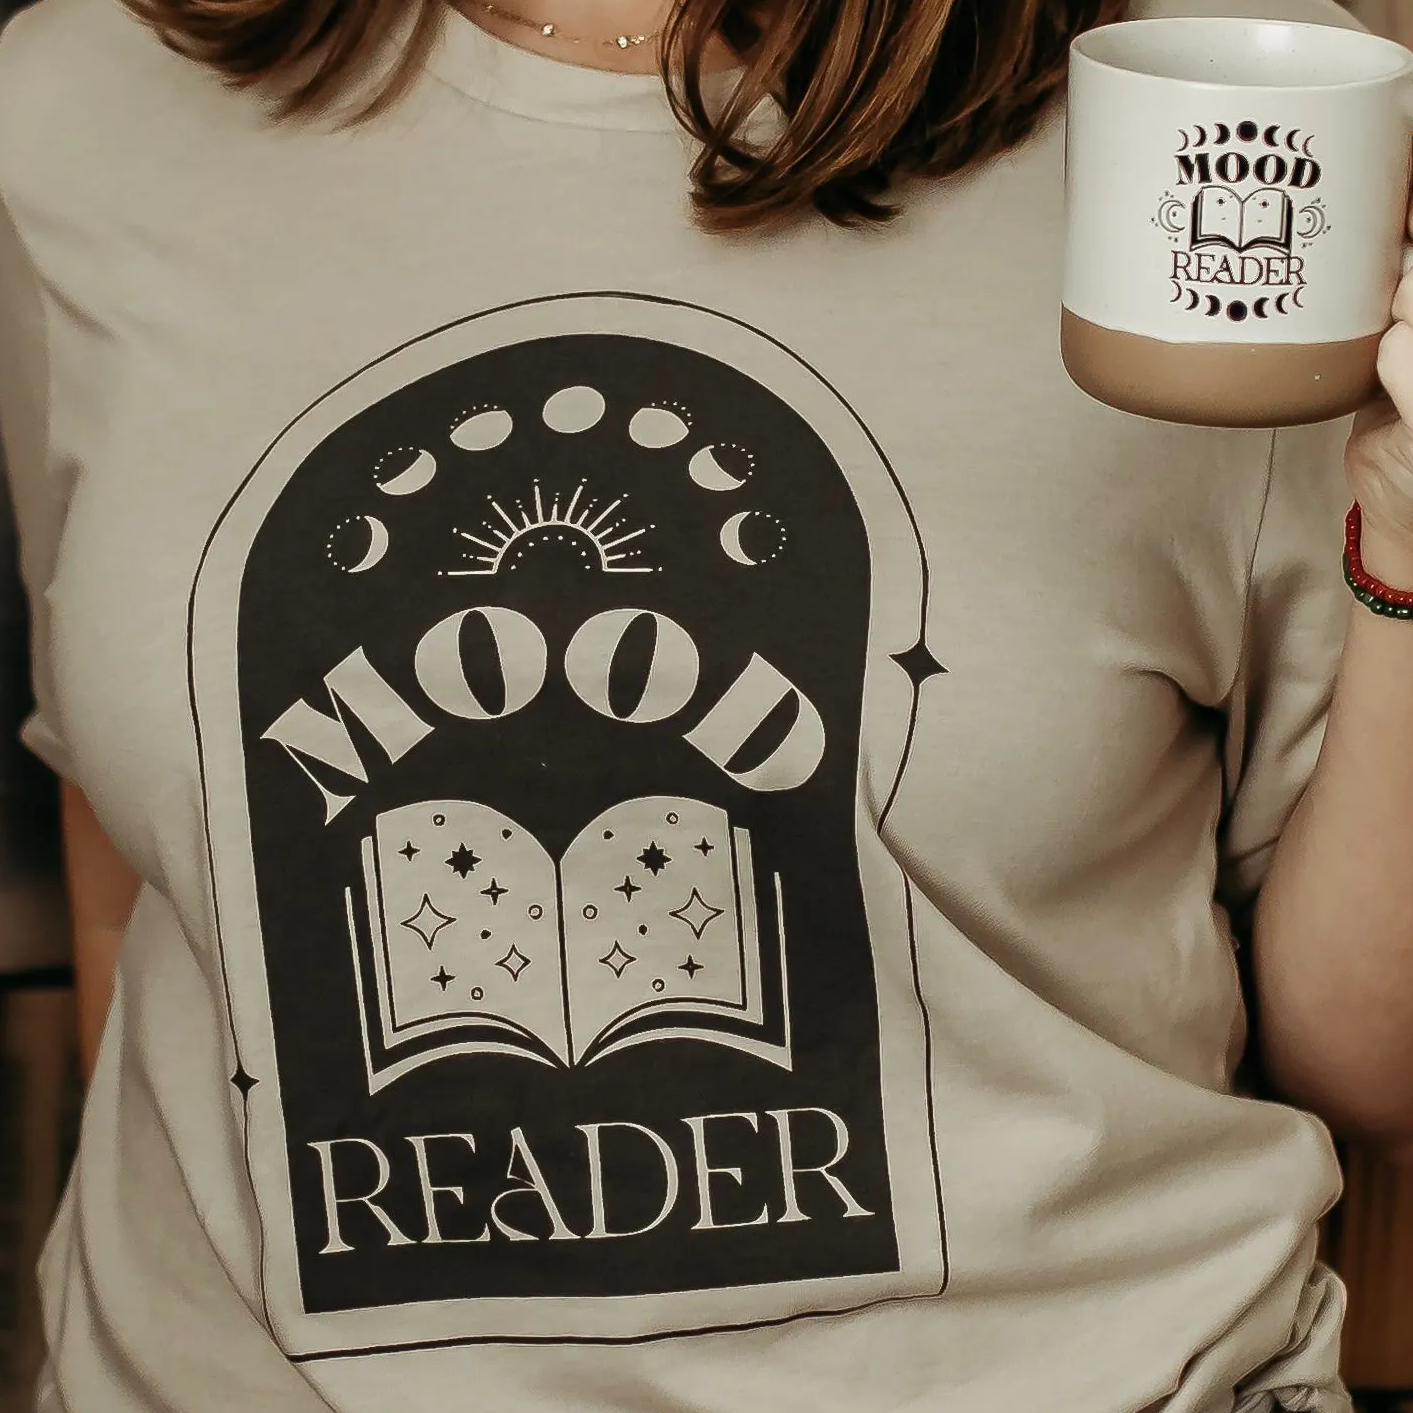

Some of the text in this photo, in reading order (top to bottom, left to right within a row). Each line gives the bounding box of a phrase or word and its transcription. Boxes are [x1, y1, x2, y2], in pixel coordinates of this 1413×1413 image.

[1175, 153, 1322, 188] MOOD
[1169, 251, 1307, 285] READER
[260, 606, 826, 826] MOOD
[306, 1107, 875, 1255] READER
